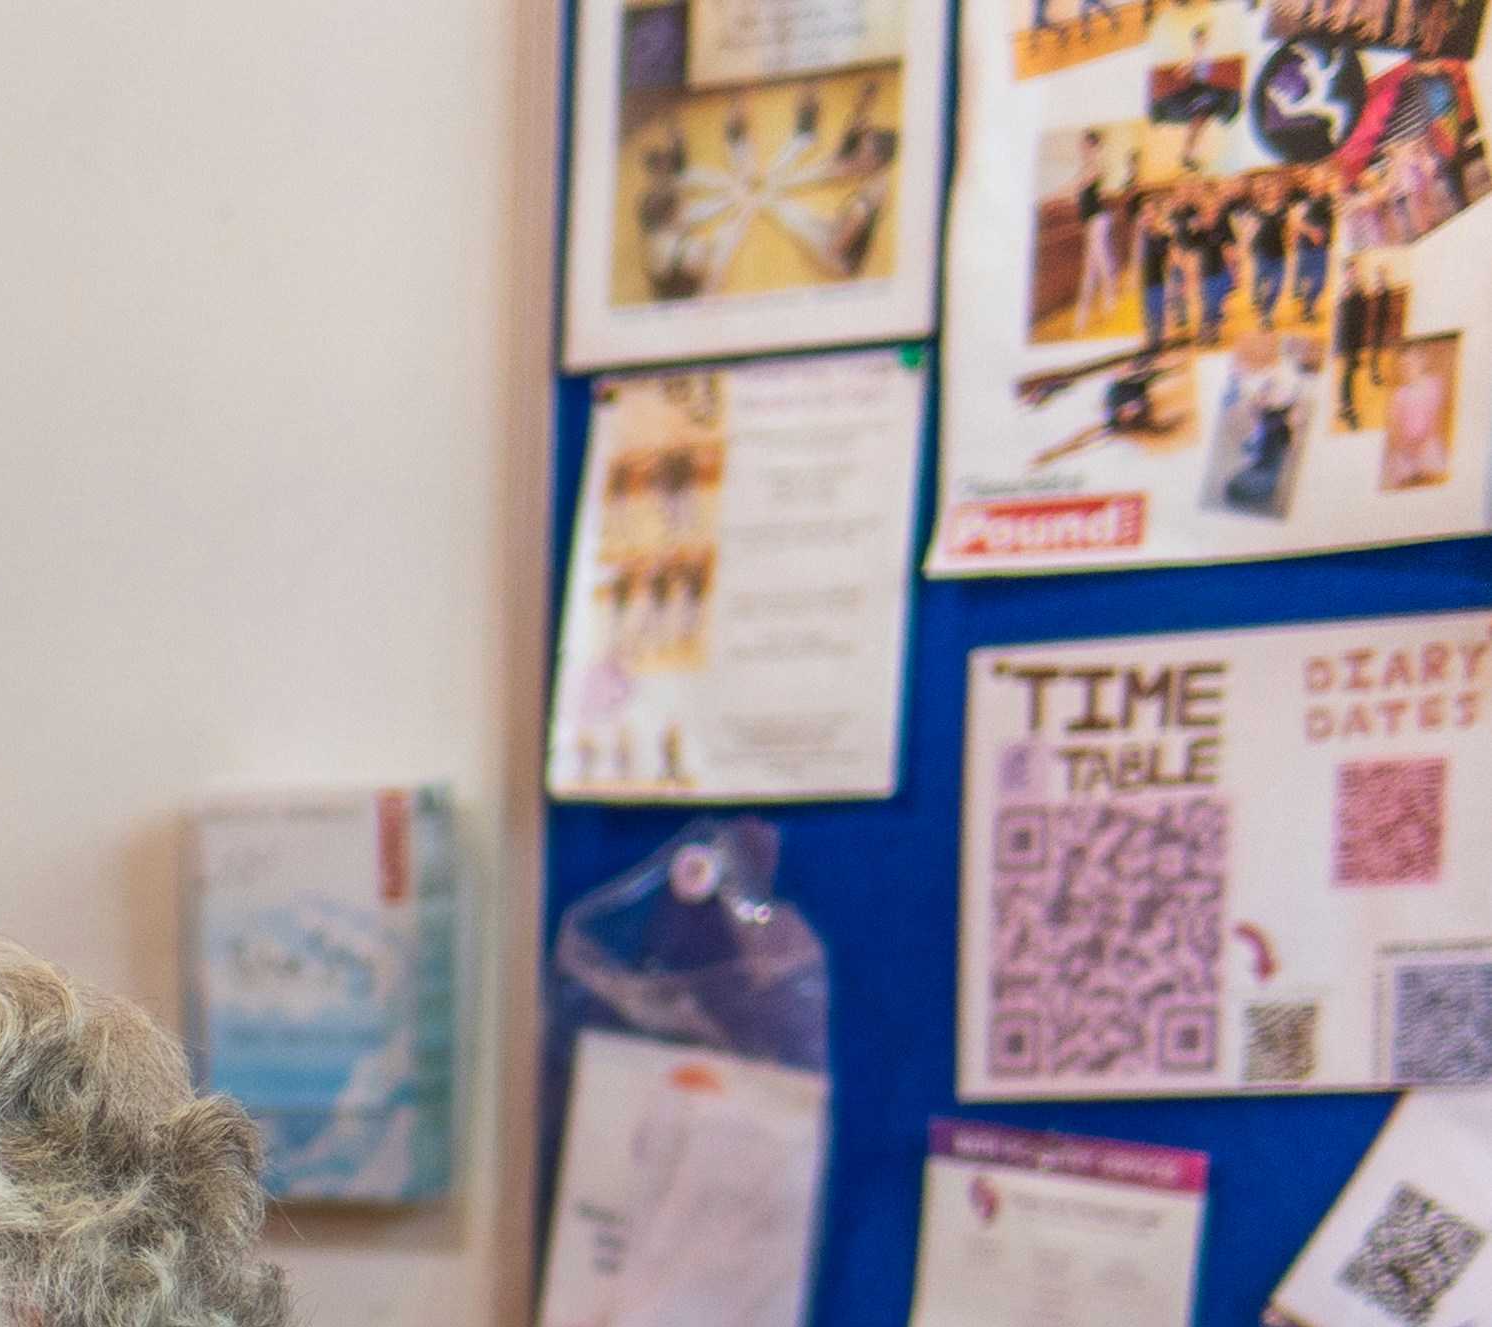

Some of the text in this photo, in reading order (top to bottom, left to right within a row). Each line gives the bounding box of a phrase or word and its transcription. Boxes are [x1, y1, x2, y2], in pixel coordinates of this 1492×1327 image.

[951, 502, 1122, 553] Pound
[1304, 641, 1491, 694] DIARY
[1016, 661, 1230, 732] TIME
[1304, 691, 1483, 742] DATES
[1058, 737, 1226, 793] TABLE
